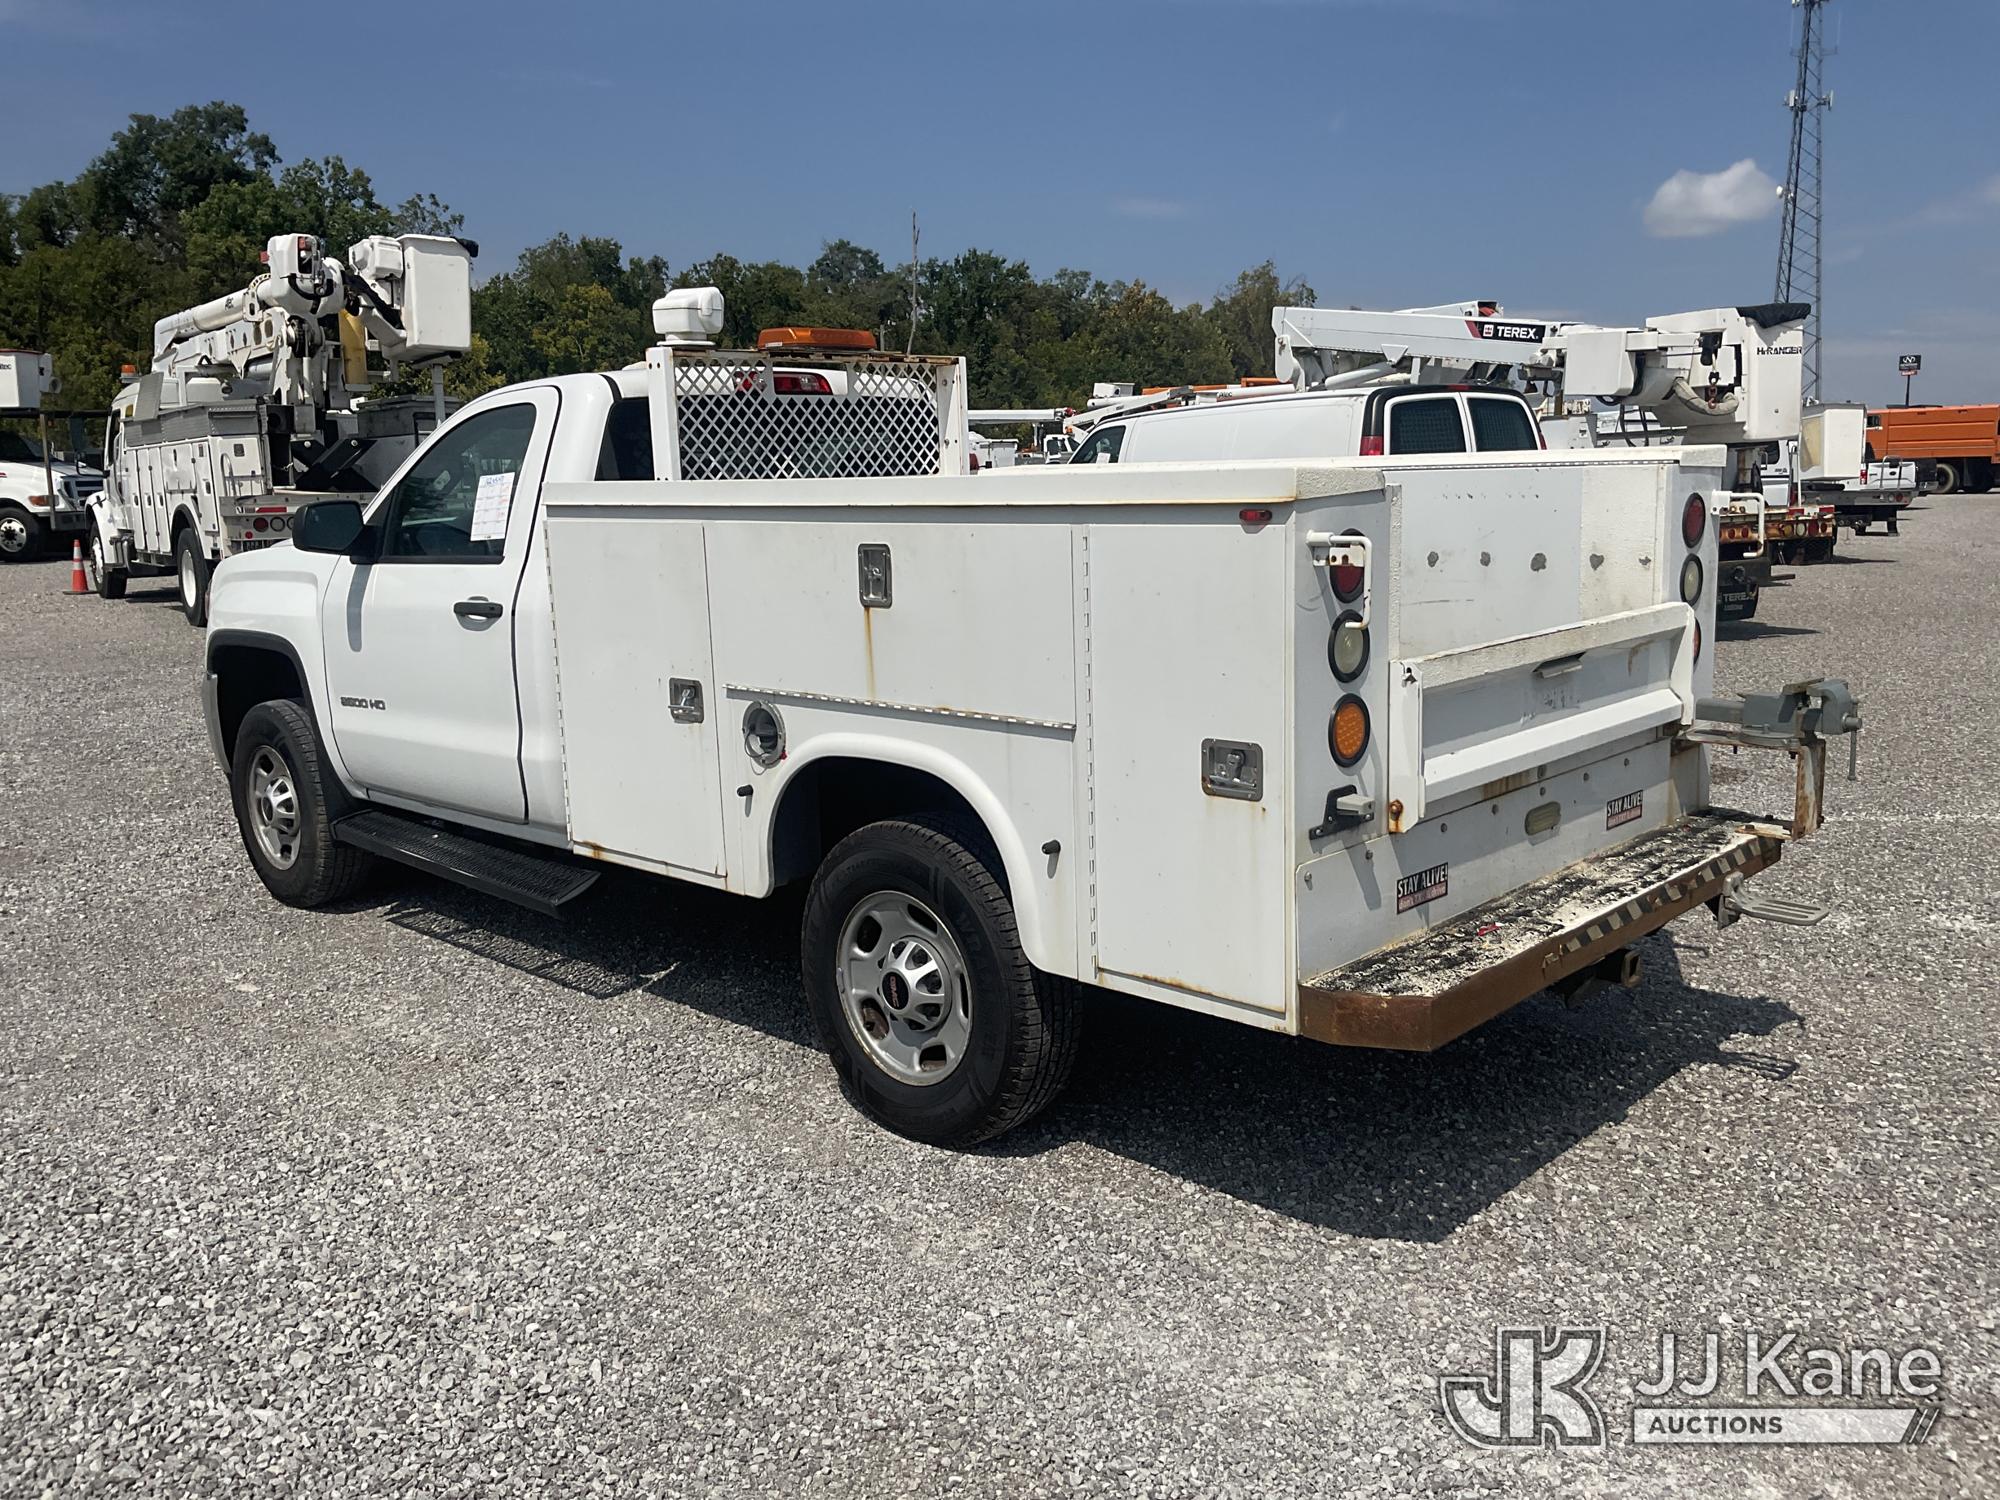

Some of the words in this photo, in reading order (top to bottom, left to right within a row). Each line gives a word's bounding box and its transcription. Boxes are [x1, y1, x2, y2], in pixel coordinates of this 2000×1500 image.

[1496, 325, 1537, 340] TEREX
[1397, 874, 1420, 898] STAY
[1420, 864, 1448, 888] ALIVE!
[889, 975, 900, 1008] GMC
